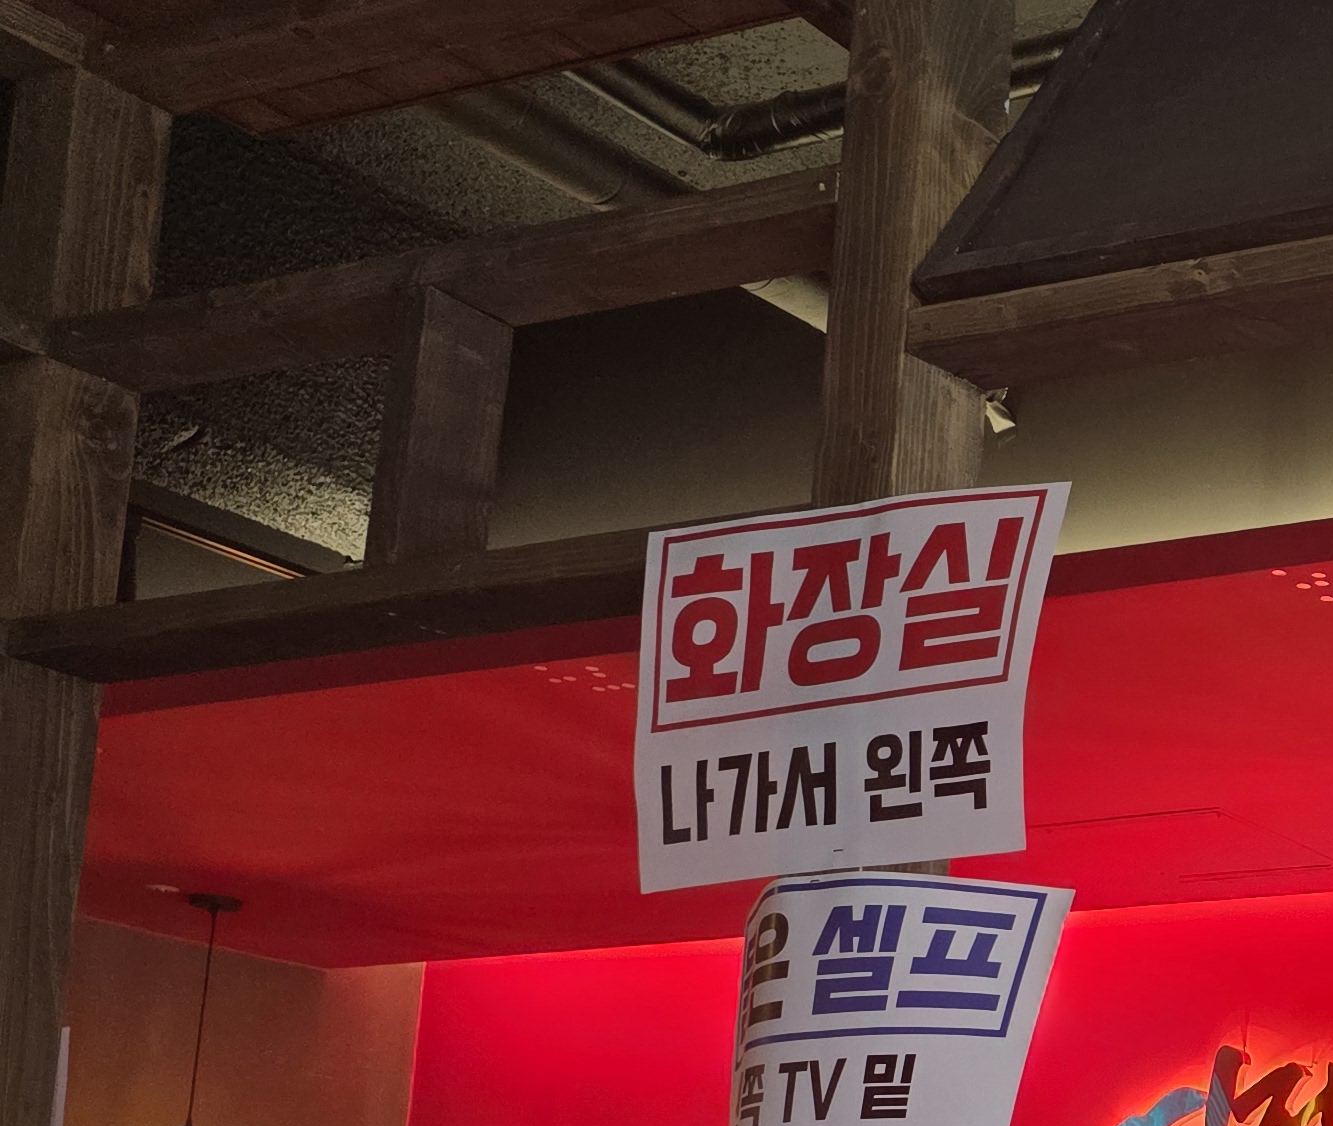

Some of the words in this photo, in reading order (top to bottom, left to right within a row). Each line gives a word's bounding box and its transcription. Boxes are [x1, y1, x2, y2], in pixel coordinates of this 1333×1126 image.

[665, 516, 1025, 703] 화장실
[660, 742, 837, 845] 나가서
[863, 721, 992, 823] 왼쪽
[811, 904, 1017, 1016] 셀프
[778, 1058, 848, 1123] TV
[859, 1053, 917, 1119] 밑
